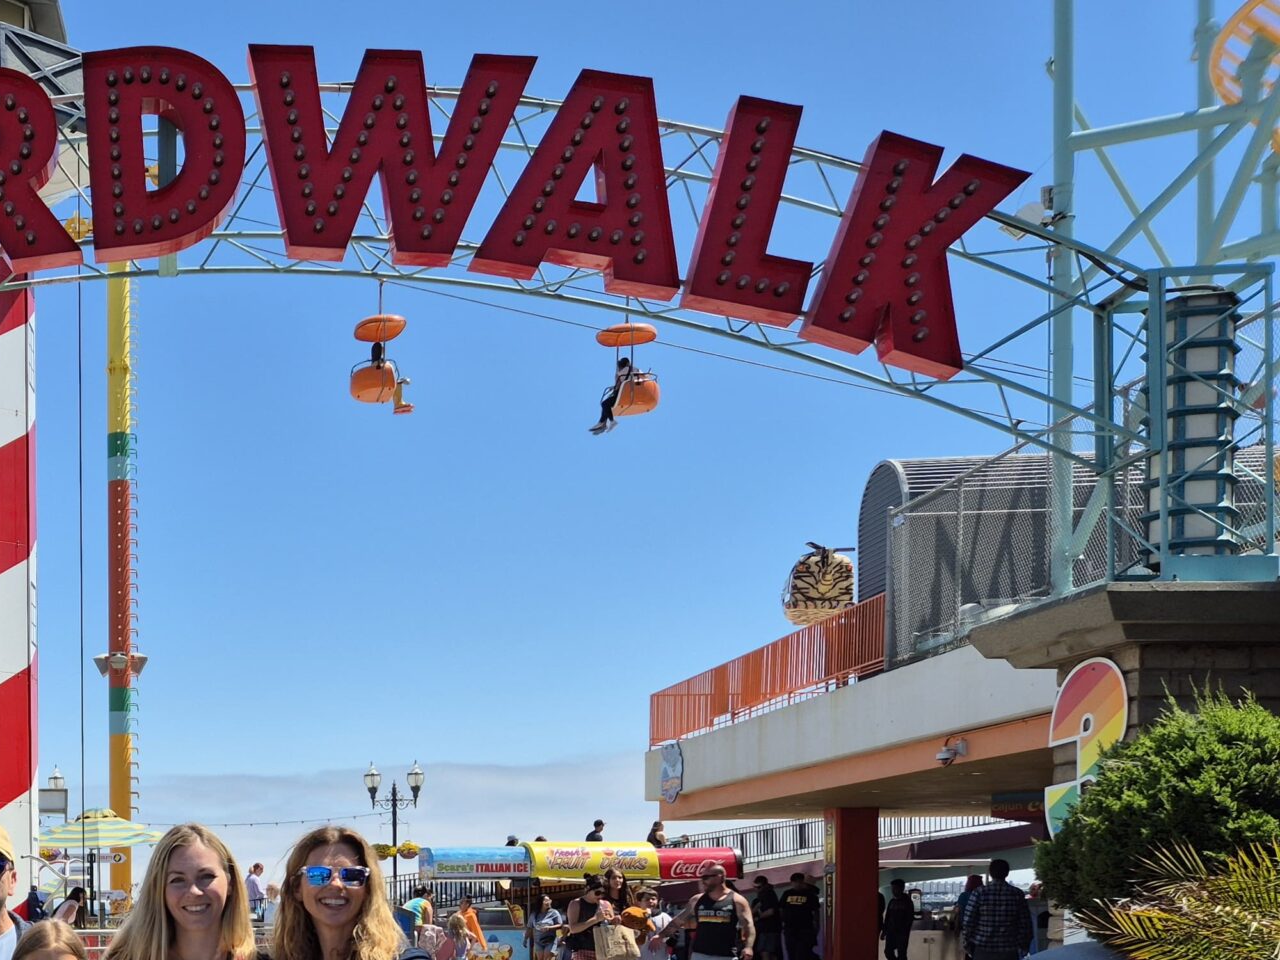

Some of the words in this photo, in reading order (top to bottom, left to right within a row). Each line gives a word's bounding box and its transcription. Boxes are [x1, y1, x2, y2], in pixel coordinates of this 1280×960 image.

[476, 863, 511, 873] ITALIAN
[513, 863, 528, 873] ICE
[600, 858, 648, 870] DRINKS
